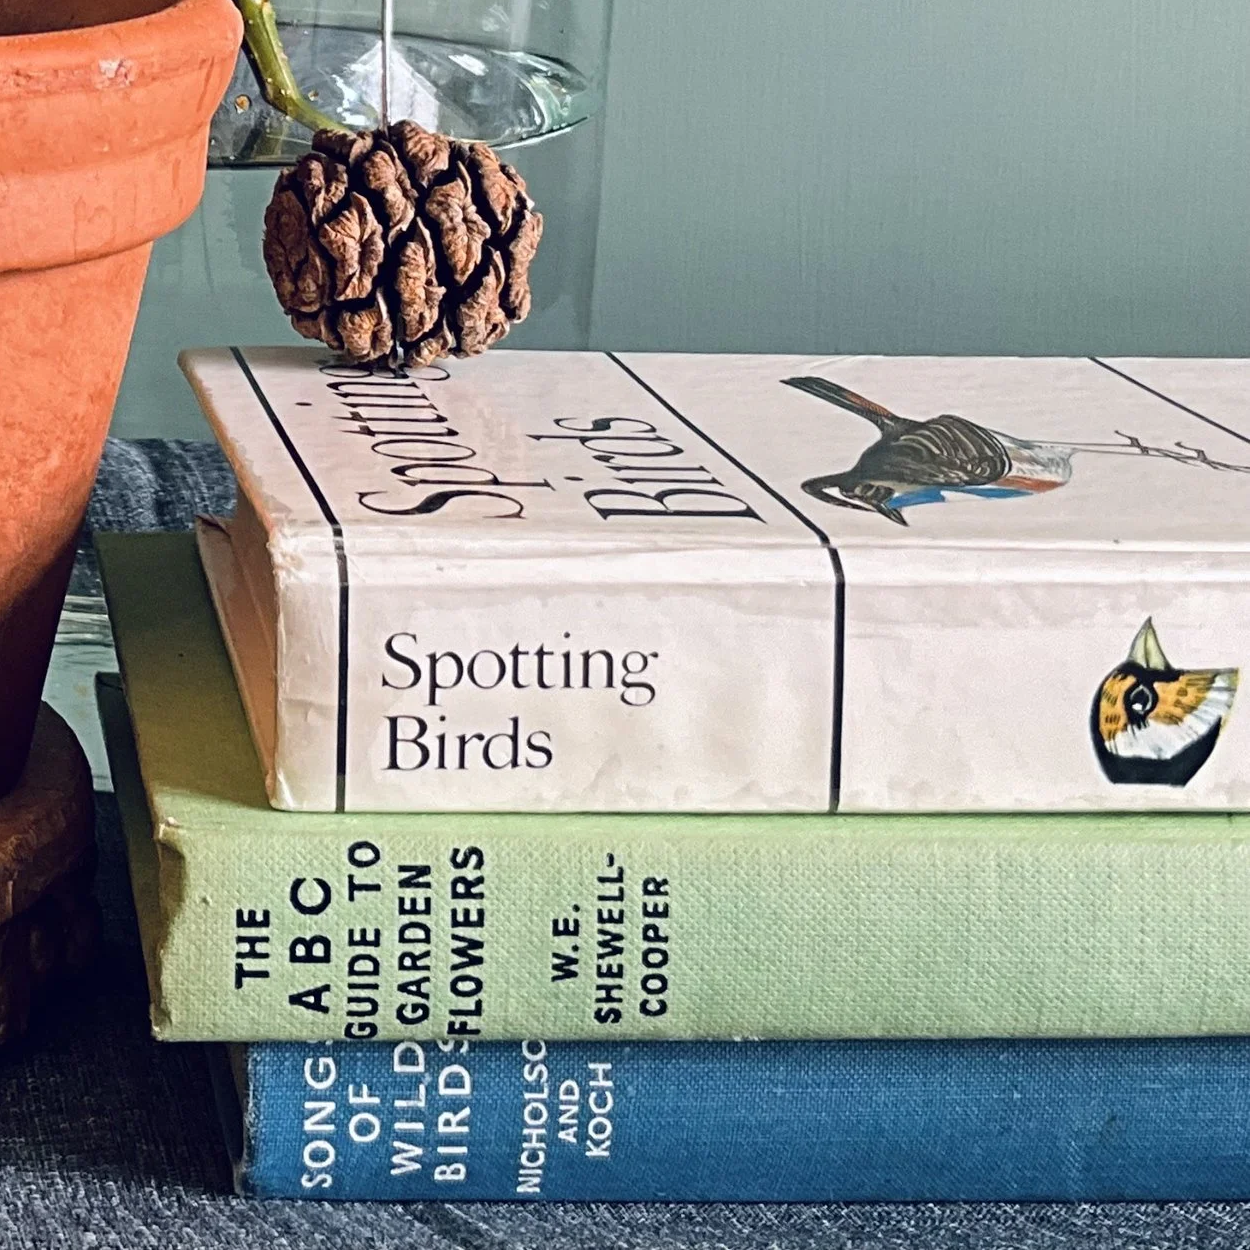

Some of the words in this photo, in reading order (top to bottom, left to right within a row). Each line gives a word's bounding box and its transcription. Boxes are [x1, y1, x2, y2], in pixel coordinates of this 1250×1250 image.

[295, 364, 556, 519] Spotting
[526, 416, 767, 524] Birds
[381, 632, 659, 706] Spotting
[386, 715, 554, 771] Birds
[289, 877, 332, 916] C
[347, 841, 382, 902] TO
[235, 908, 271, 989] THE
[289, 934, 332, 964] B
[344, 927, 381, 1040] GUIDE
[396, 864, 432, 1026] GARDEN
[447, 846, 485, 1036] FLOWERS
[593, 853, 625, 1024] SHEWELL-
[639, 877, 670, 1017] COOPER
[288, 983, 331, 1014] A
[300, 1040, 337, 1189] SONG
[348, 1083, 381, 1143] OF
[390, 1040, 425, 1176] WILD
[557, 1079, 580, 1144] AND
[585, 1062, 614, 1157] KOCH
